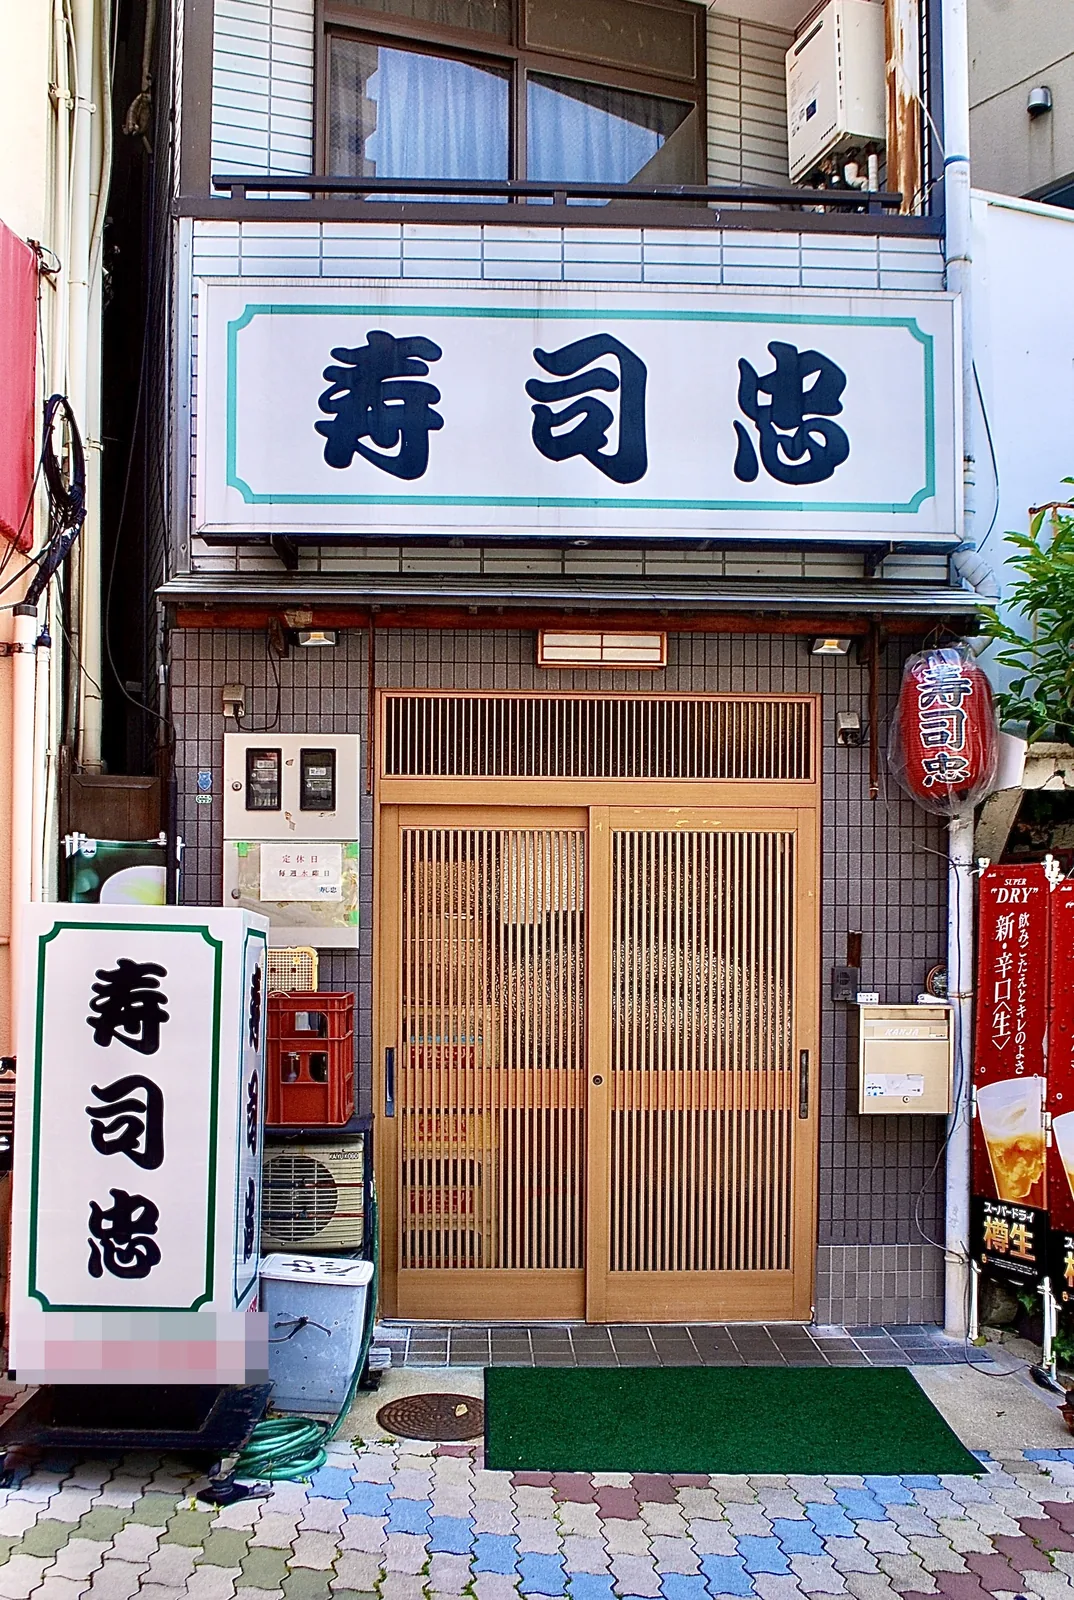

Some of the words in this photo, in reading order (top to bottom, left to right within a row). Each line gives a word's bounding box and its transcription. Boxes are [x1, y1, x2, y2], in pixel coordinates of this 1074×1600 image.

[314, 329, 851, 485] 寿司忠
[917, 664, 973, 788] 寿司忠
[282, 854, 318, 864] 定休日
[1003, 877, 1027, 886] SUPER
[1014, 911, 1030, 1075] 飲みごたえとキレのよさ
[86, 957, 171, 1280] 寿司忠
[983, 1215, 1036, 1261] 樽生
[984, 1201, 1034, 1223] スーパードライ
